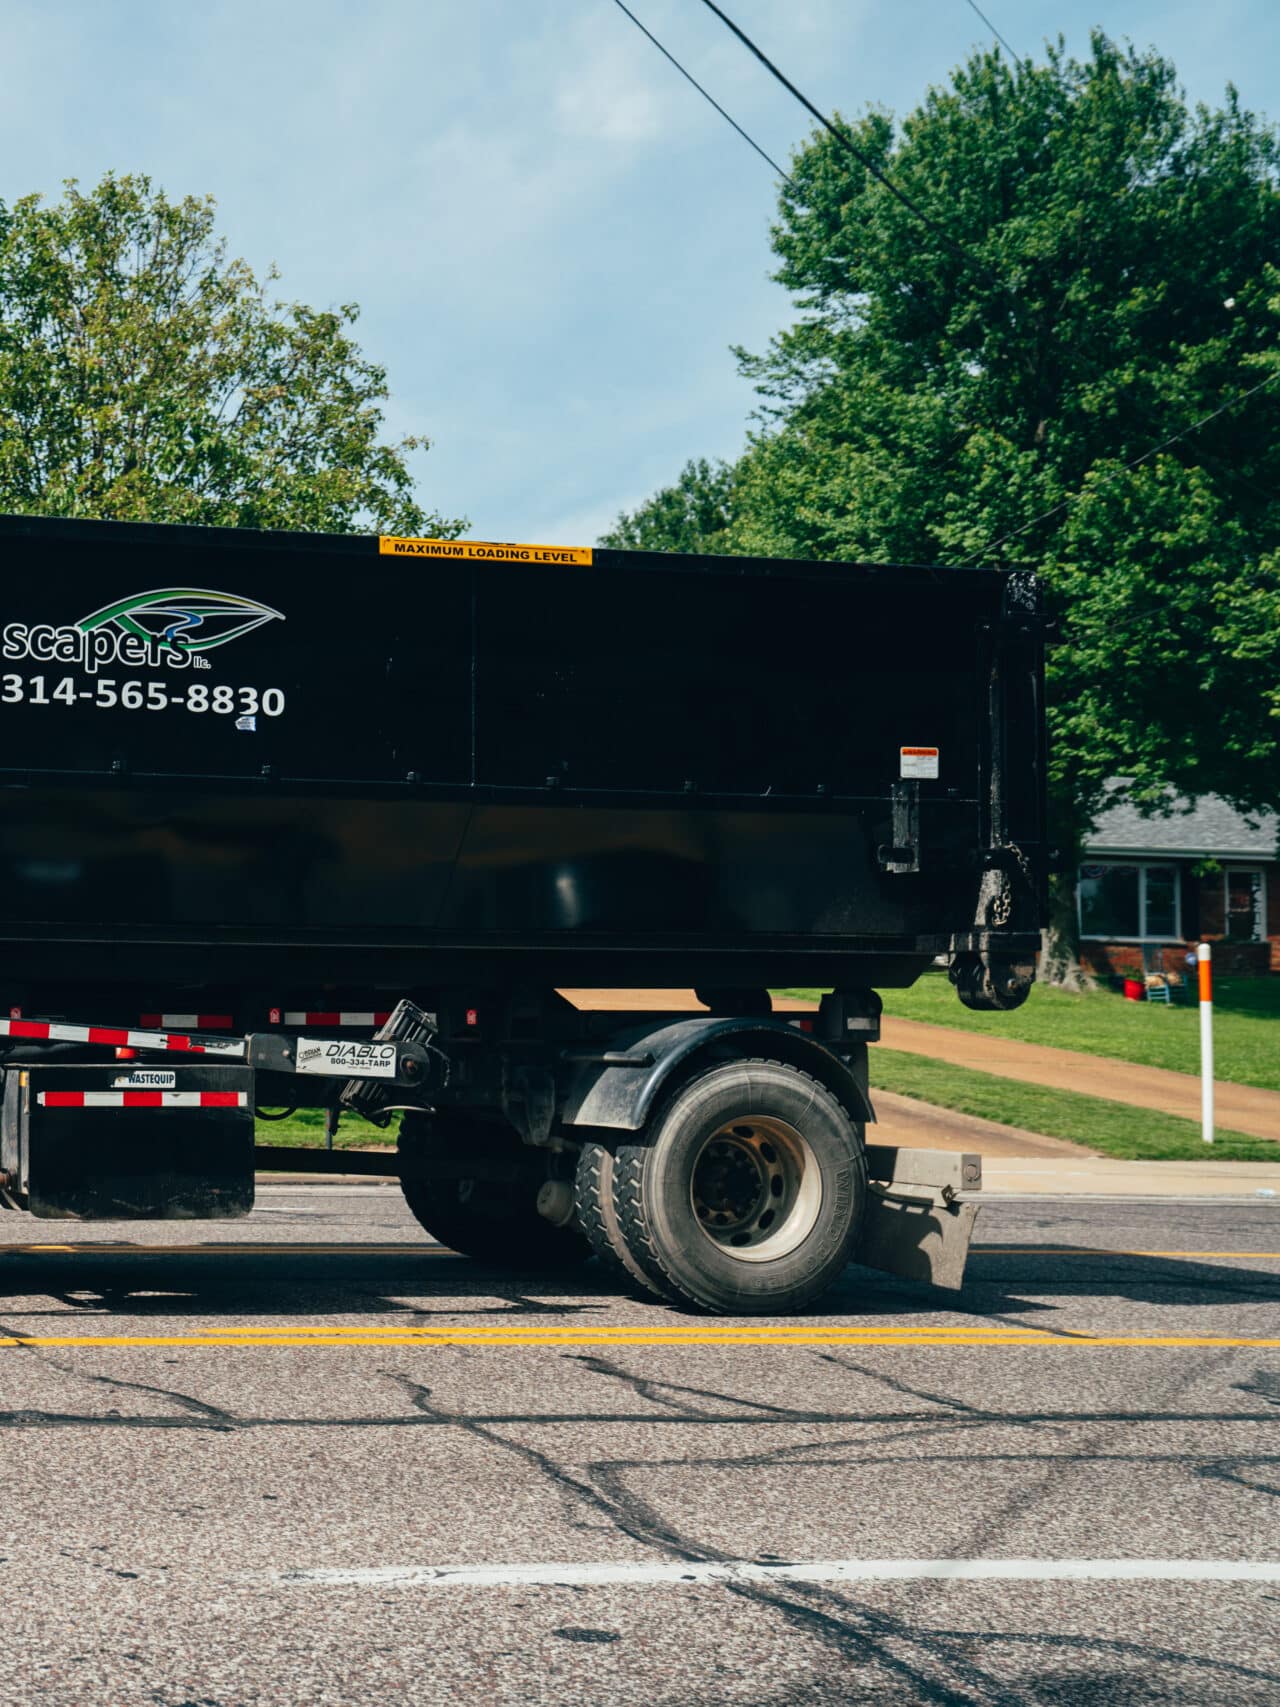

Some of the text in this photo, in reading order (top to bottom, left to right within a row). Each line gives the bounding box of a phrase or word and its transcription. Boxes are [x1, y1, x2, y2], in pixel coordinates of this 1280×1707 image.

[394, 543, 578, 562] MAXIMUM LOADING LEVEL
[2, 623, 193, 674] scapers
[1, 674, 286, 717] 314-565-8830
[326, 1044, 395, 1059] DIABLO
[331, 1057, 391, 1067] 800-334-TARP
[128, 1074, 175, 1084] WASTEQUIP
